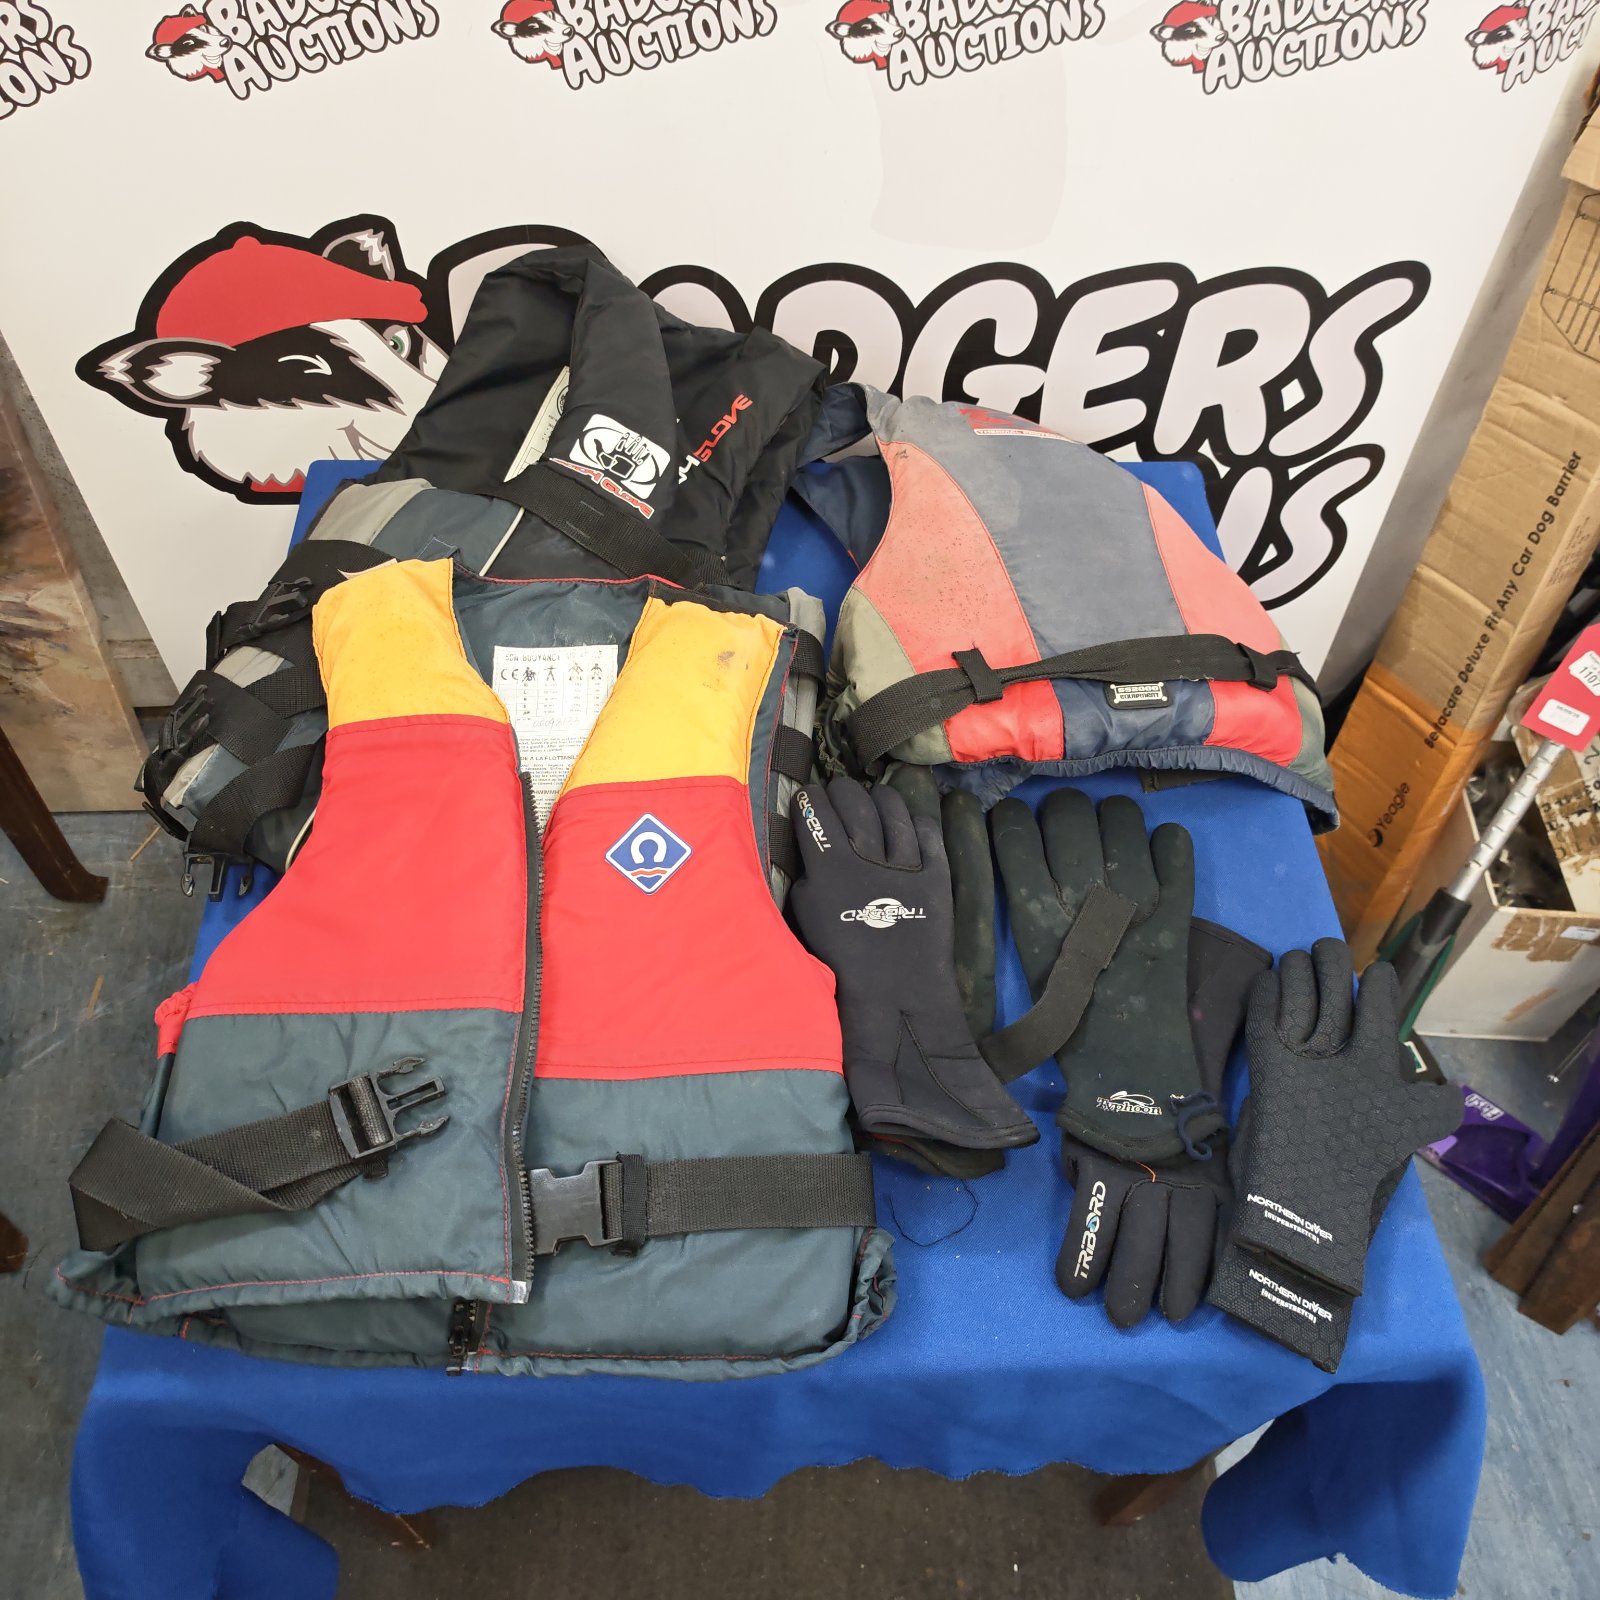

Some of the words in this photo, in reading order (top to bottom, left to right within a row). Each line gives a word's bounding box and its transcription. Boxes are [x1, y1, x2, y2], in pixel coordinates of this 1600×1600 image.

[1202, 0, 1430, 95] AUCTIONS
[427, 224, 1430, 468] DGERS
[1457, 633, 1490, 683] Deluxe
[1496, 579, 1519, 612] Any
[1512, 546, 1533, 576] Car
[1527, 510, 1555, 545] Dog
[1545, 451, 1582, 507] Barrier
[1247, 1193, 1305, 1226] NORTHERN
[1304, 1222, 1333, 1242] DIVER
[1248, 1268, 1302, 1304] NORTHERN
[1301, 1300, 1333, 1322] DIVER
